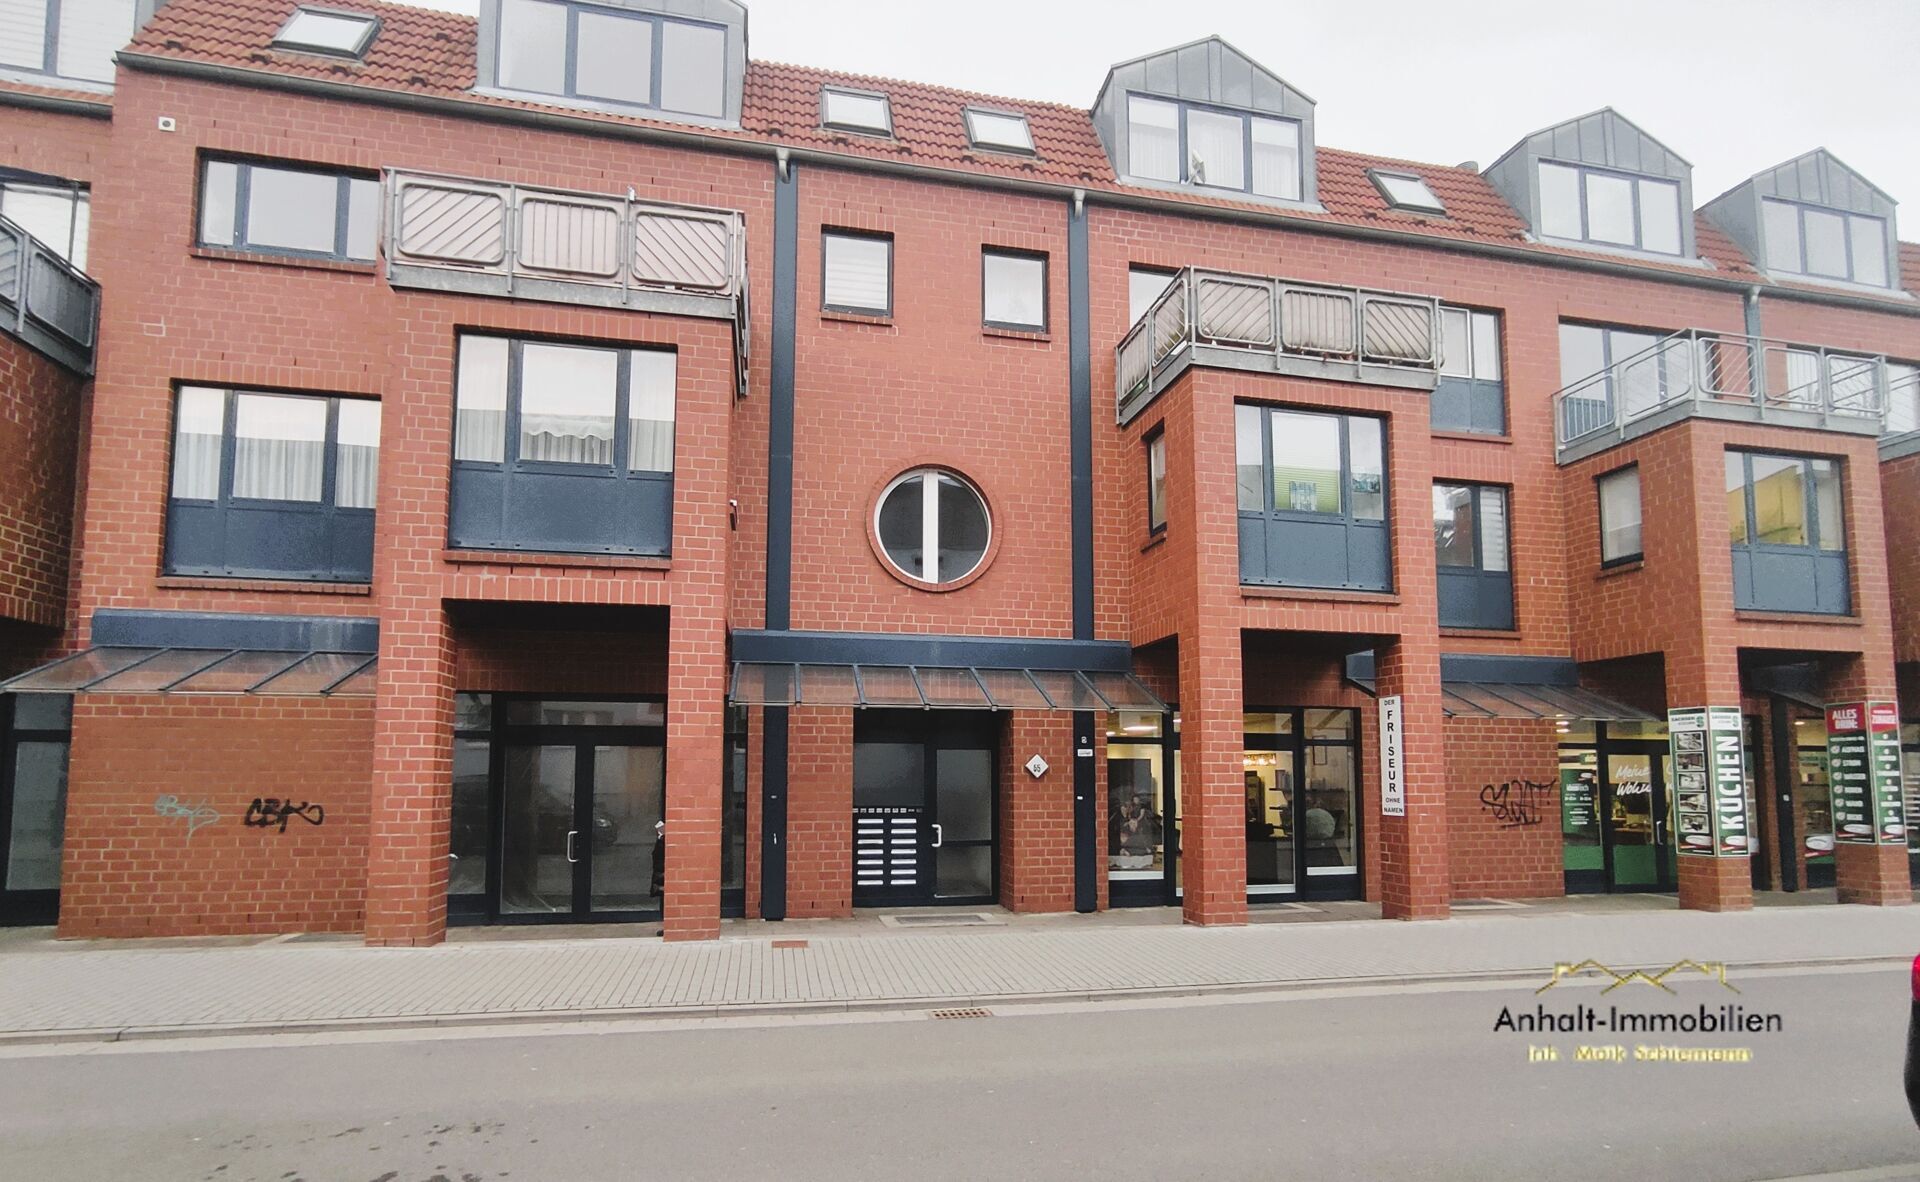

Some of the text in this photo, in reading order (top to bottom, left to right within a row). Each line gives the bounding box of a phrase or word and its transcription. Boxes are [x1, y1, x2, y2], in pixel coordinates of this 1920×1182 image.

[1387, 710, 1397, 793] FRISEUR
[1832, 708, 1857, 721] ALLES
[1715, 736, 1745, 830] KÜCHEN
